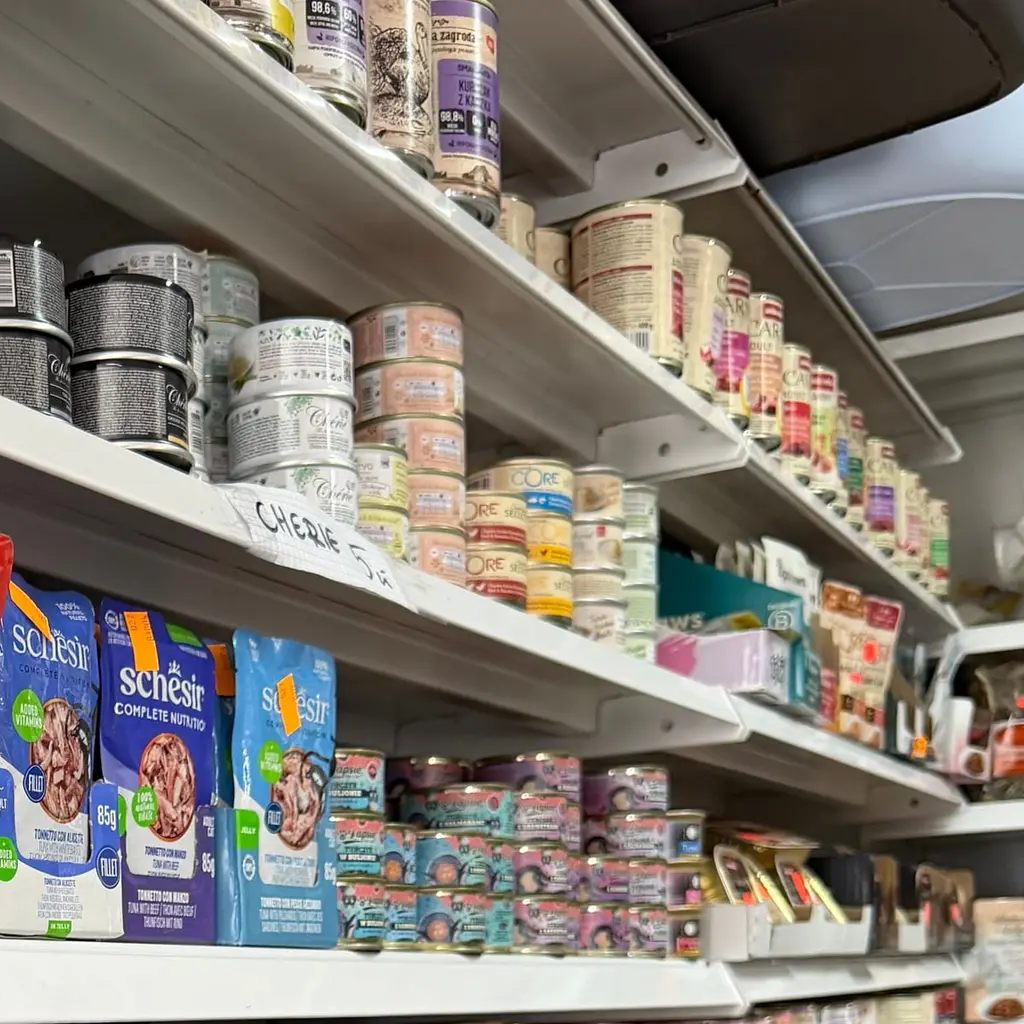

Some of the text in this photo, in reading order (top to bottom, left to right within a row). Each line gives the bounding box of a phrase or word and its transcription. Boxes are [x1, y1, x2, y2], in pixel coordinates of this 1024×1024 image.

[511, 468, 559, 487] CORE
[256, 501, 340, 554] CHERIE
[114, 702, 169, 723] COMPLETE
[28, 775, 44, 792] FILLET
[97, 805, 117, 831] 85g
[101, 858, 118, 878] FILLET
